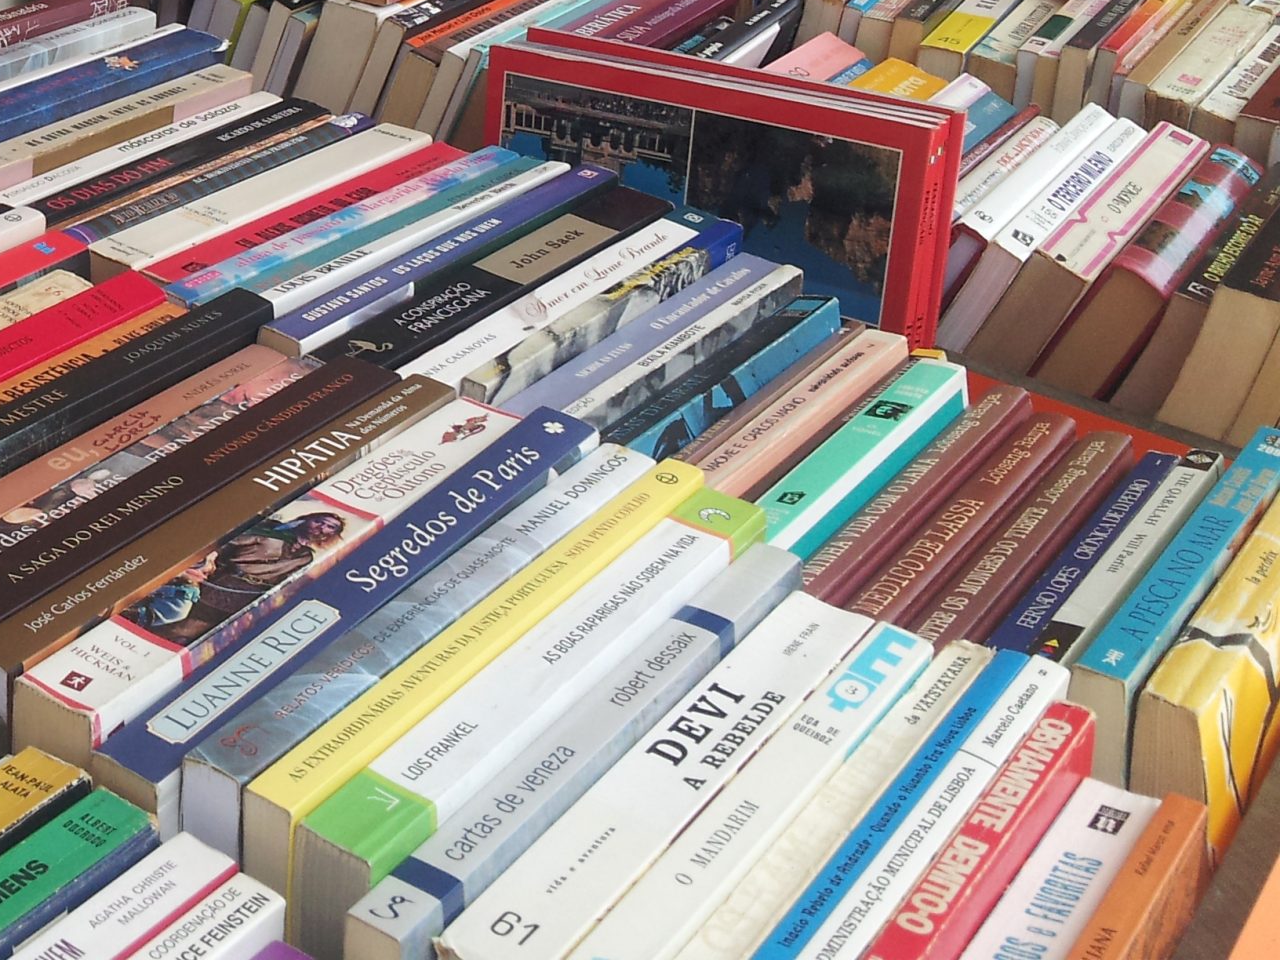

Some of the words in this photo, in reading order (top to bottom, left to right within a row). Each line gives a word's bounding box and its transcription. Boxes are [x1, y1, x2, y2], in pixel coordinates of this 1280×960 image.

[509, 245, 547, 269] John
[551, 227, 585, 252] Sack
[253, 428, 363, 491] HIPÁTIA
[517, 496, 569, 535] MANUEL
[569, 453, 627, 498] DOMINGOS
[8, 569, 23, 584] A
[19, 539, 67, 575] SAGA
[66, 526, 92, 549] DO
[91, 511, 120, 532] REI
[117, 475, 184, 516] MENINO
[345, 508, 459, 590] Segredos
[462, 475, 485, 514] de
[486, 444, 541, 493] Paris
[930, 496, 986, 541] LASSA
[24, 610, 53, 634] José
[51, 586, 91, 616] Carlos
[88, 553, 148, 592] Fernández
[1052, 565, 1079, 597] LOPES
[71, 647, 135, 682] HICKMAN
[165, 653, 272, 731] LUANNE
[273, 610, 327, 655] RICE
[609, 667, 658, 708] robert
[649, 631, 697, 672] dessaix
[646, 682, 744, 766] DEVI
[982, 710, 1018, 748] Marcelo
[1010, 683, 1040, 720] Caetano
[444, 813, 502, 861] cartas
[496, 790, 525, 818] de
[521, 745, 577, 793] veneza
[691, 800, 760, 868] MANDARIM
[1025, 852, 1104, 927] FAVORITAS
